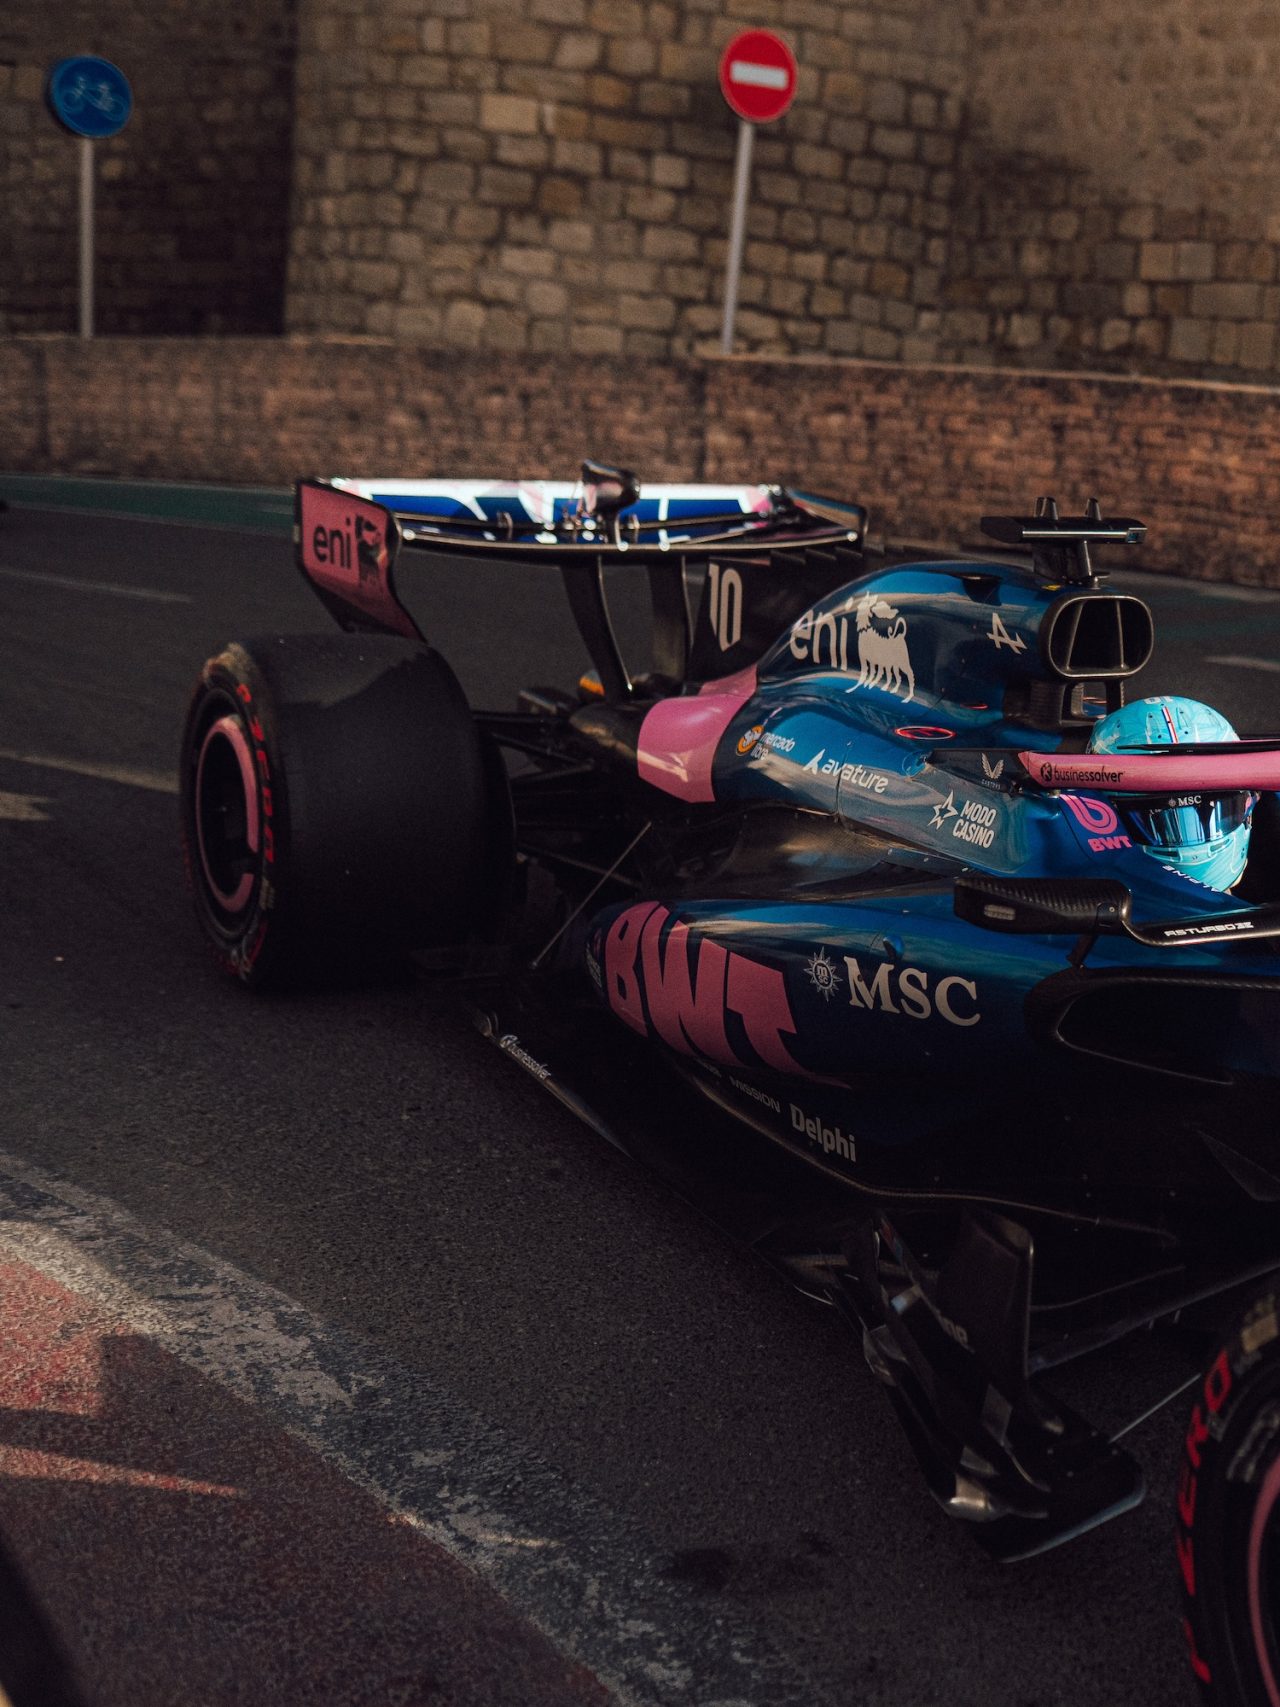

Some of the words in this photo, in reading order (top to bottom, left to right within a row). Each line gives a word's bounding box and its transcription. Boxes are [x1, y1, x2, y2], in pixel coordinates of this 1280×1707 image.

[313, 517, 351, 570] eni
[708, 563, 743, 652] 10
[789, 596, 854, 671] eni
[750, 743, 770, 761] libre
[759, 730, 796, 752] mercado
[821, 758, 889, 794] avature
[1053, 768, 1124, 784] businessolver
[960, 800, 998, 827] MODO
[1177, 794, 1203, 807] MSC
[952, 818, 995, 849] CASINO
[1087, 835, 1133, 853] BWT
[605, 900, 852, 1090] BWT
[843, 955, 982, 1027] MSC
[790, 1102, 857, 1163] Delphi
